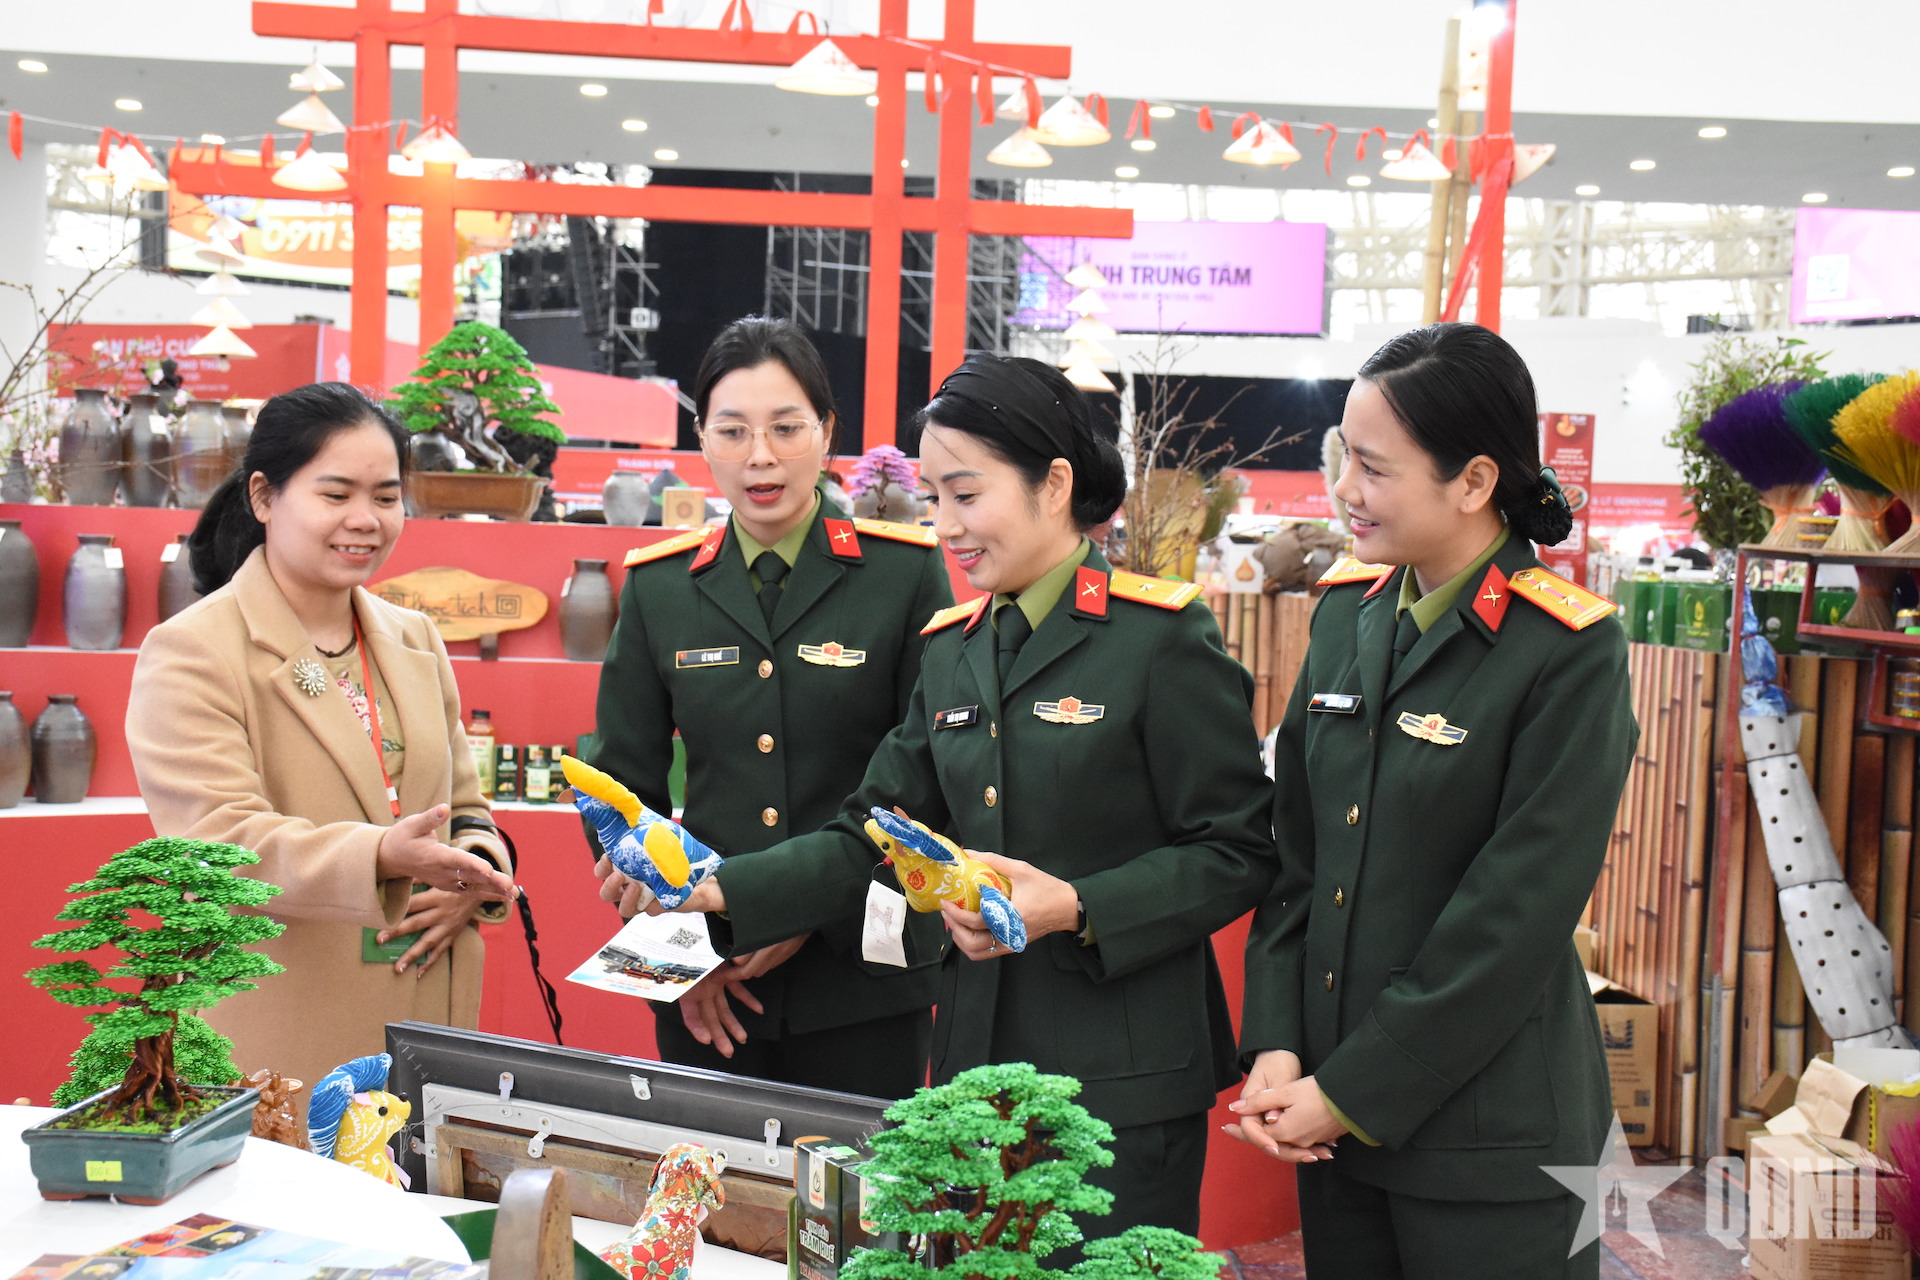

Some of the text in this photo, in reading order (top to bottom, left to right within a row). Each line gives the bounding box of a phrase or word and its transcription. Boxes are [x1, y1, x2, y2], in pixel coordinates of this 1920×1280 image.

[262, 220, 336, 252] 0911
[1131, 266, 1200, 286] TRUNG
[1209, 261, 1251, 286] TÂM
